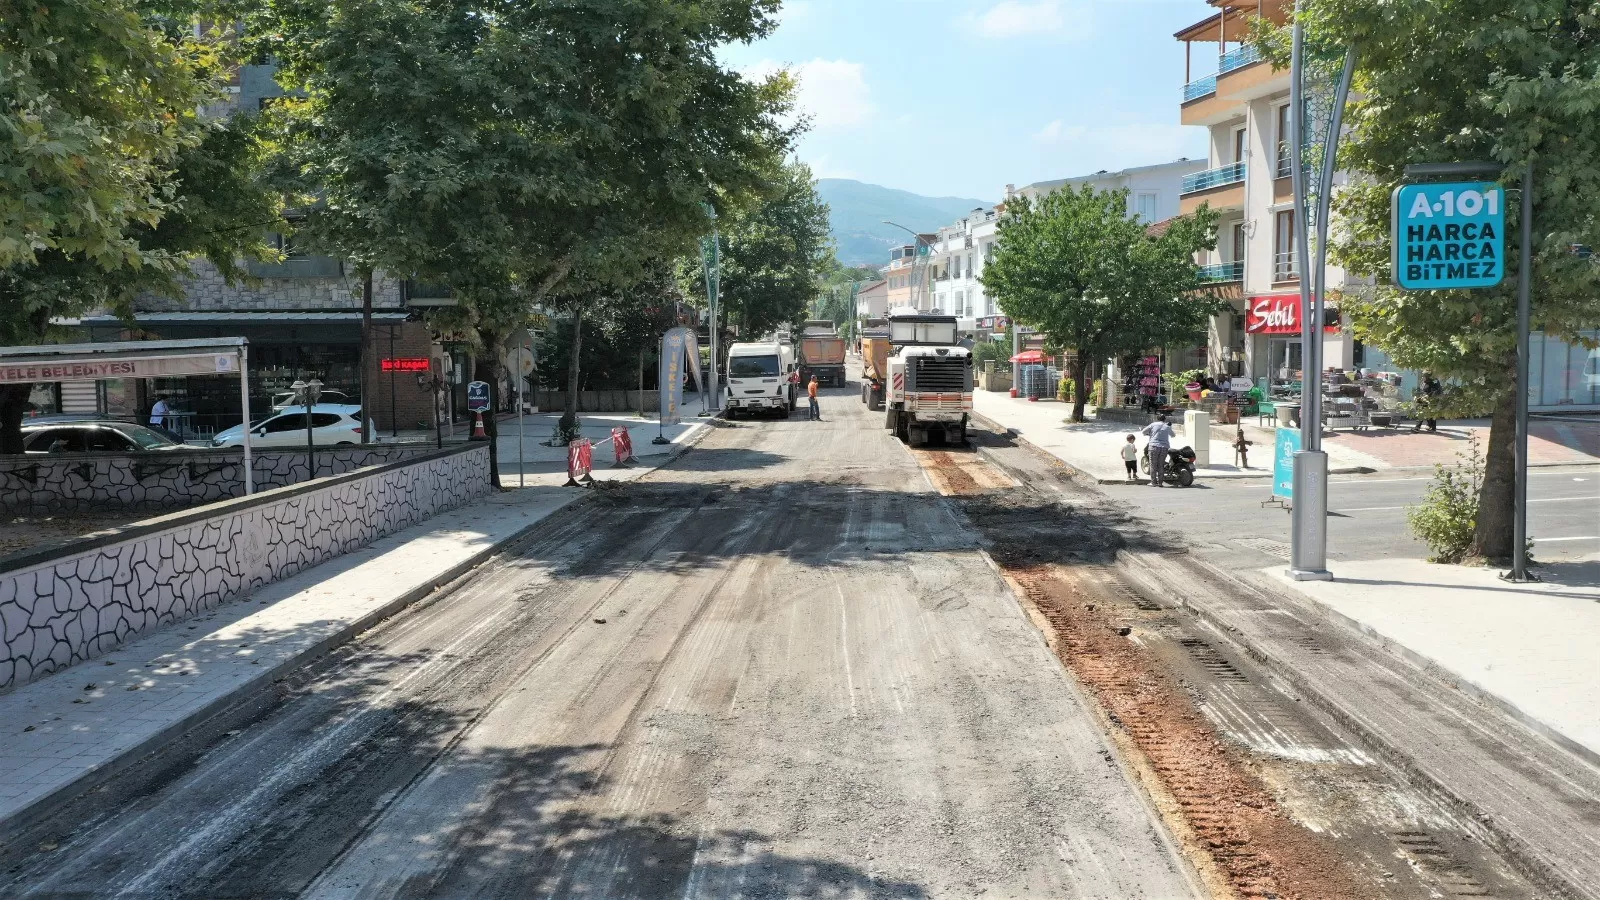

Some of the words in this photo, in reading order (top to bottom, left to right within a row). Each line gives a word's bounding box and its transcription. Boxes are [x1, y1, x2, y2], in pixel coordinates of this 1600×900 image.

[1407, 222, 1496, 242] HARCA
[1407, 242, 1495, 262] HARCA
[1248, 299, 1296, 331] Sebil
